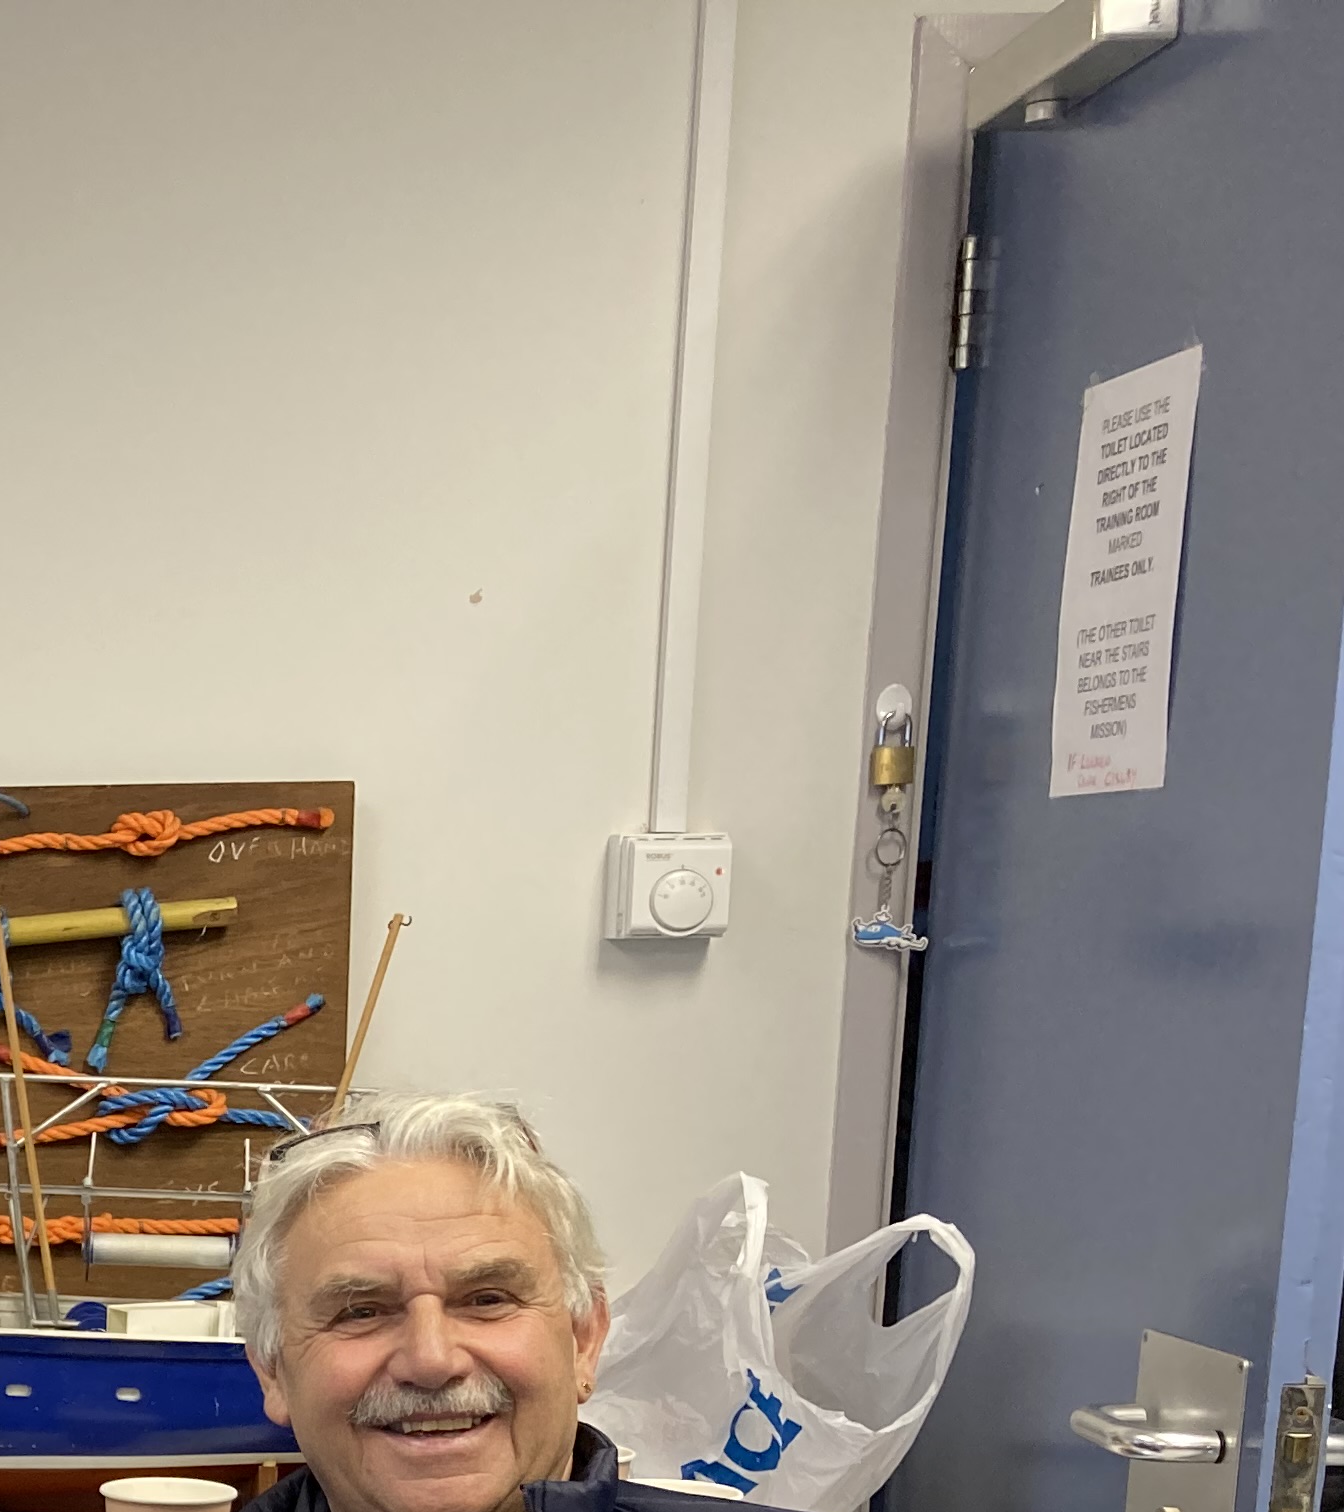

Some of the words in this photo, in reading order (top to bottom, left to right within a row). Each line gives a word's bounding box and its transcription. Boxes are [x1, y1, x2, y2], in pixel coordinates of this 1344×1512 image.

[1102, 408, 1134, 435] PLEASE
[1134, 402, 1153, 423] USE
[1154, 396, 1171, 416] THE
[1101, 436, 1128, 460] TOILET
[1129, 423, 1168, 450] LOCATED
[1097, 459, 1137, 485] DIRECTLY
[1138, 454, 1150, 472] TO
[1152, 448, 1168, 466] THE
[1102, 484, 1127, 508] RIGHT
[1128, 481, 1141, 500] OF
[1142, 476, 1158, 496] THE
[1096, 508, 1134, 534] TRAINING
[1135, 500, 1160, 521] ROOM
[1108, 530, 1142, 555] MARKED
[1090, 562, 1130, 588] TRAINEES
[1077, 626, 1097, 648] (THE
[1098, 620, 1127, 641] OTHER
[1130, 614, 1156, 634] TOILET
[1078, 650, 1102, 669] NEAR
[1105, 647, 1120, 664] THE
[1122, 640, 1150, 661] STAIRS
[1078, 672, 1116, 694] BELONGS
[1119, 669, 1130, 685] TO
[1132, 666, 1147, 682] THE
[1084, 694, 1136, 716] FISHERMENS
